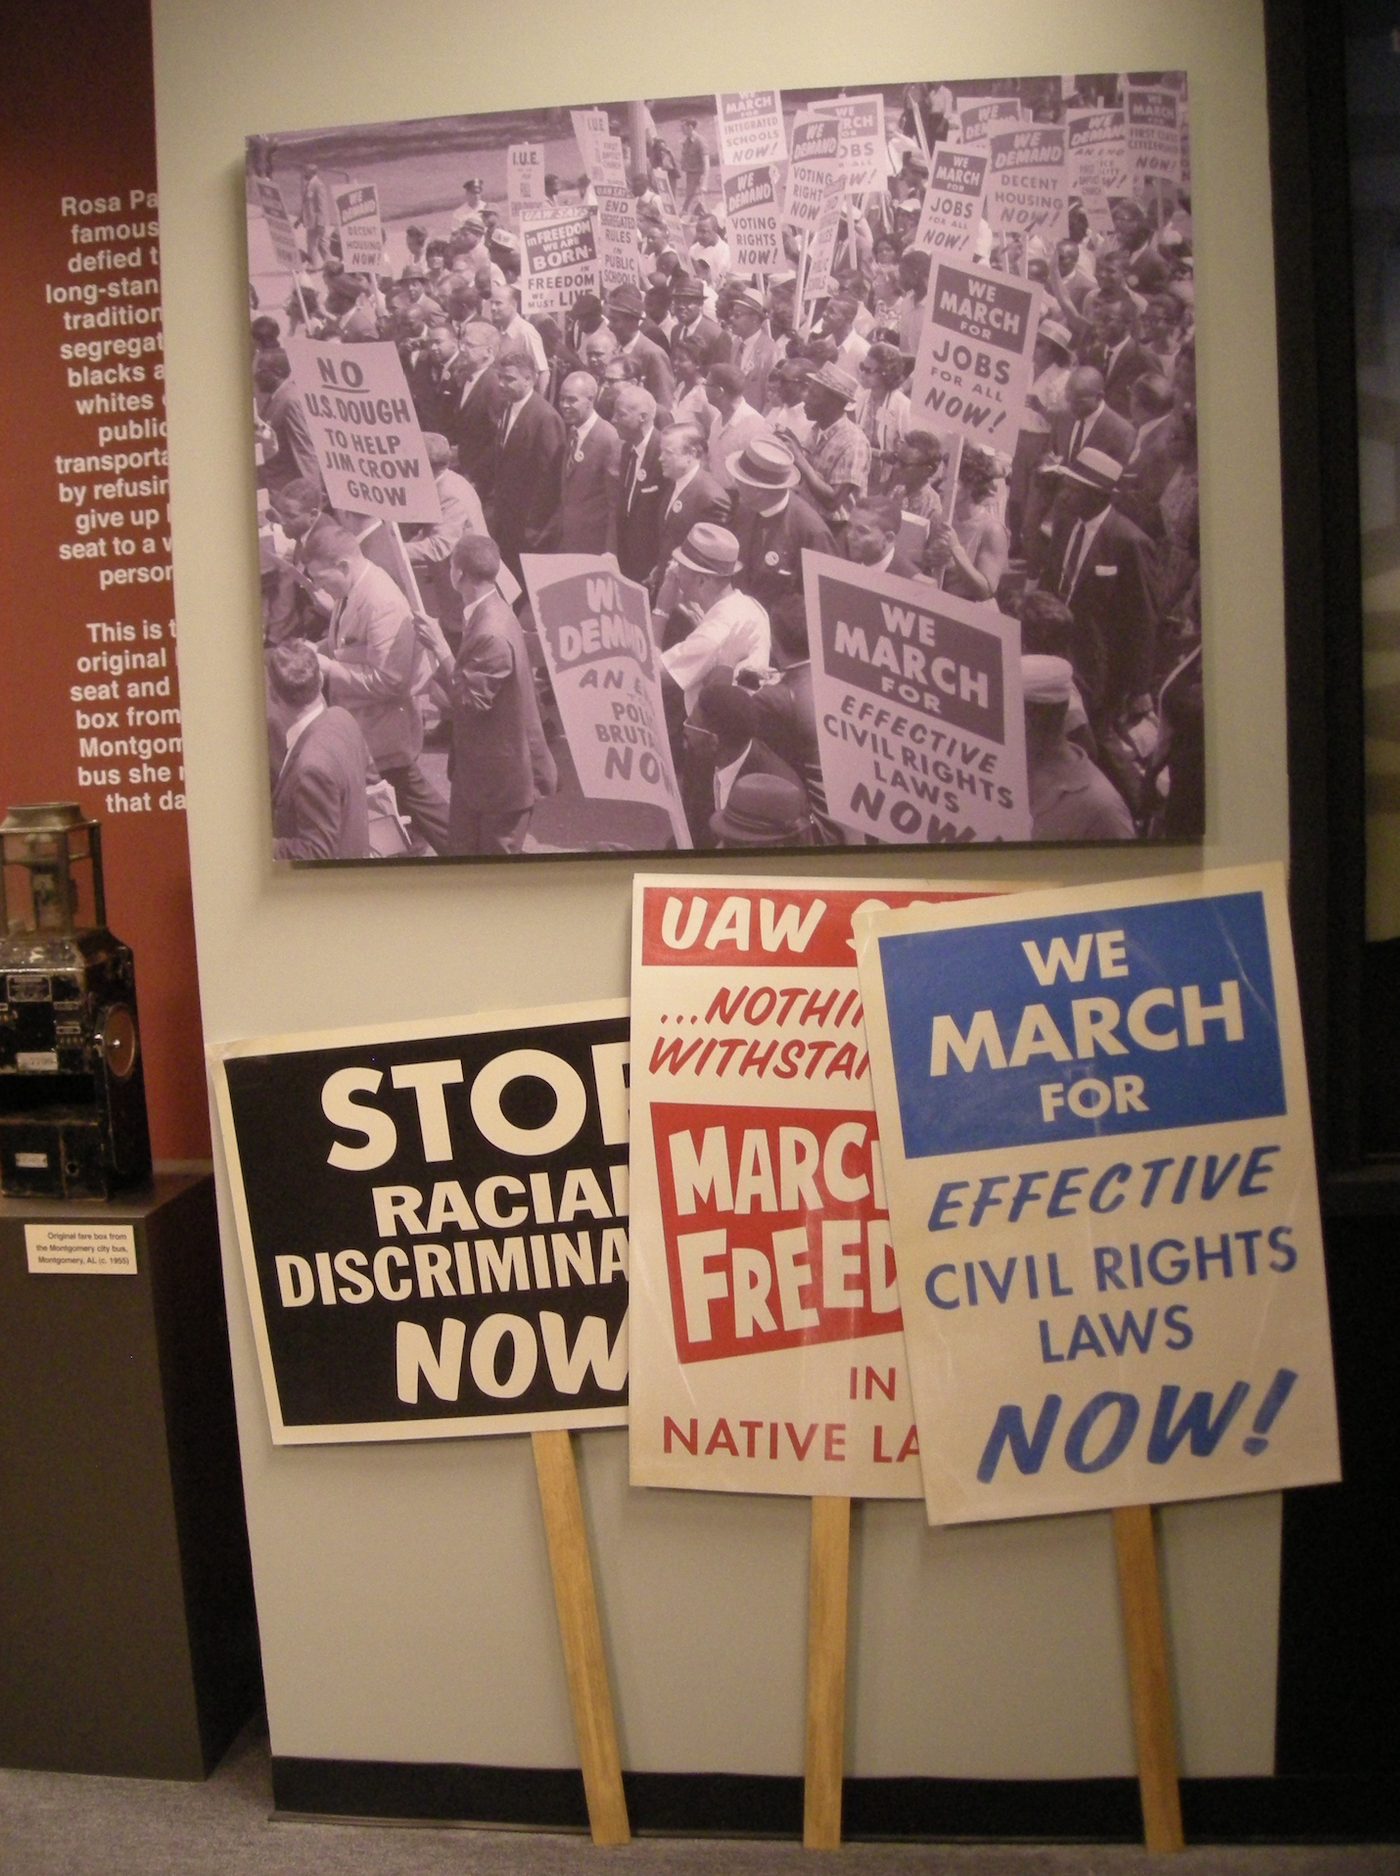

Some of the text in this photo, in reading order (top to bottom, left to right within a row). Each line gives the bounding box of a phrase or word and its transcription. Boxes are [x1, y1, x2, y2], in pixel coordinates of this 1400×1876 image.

[726, 97, 773, 115] MARCH
[724, 117, 779, 136] INTEGRATED
[726, 131, 780, 147] SCHOOLS
[805, 122, 825, 141] WE
[732, 142, 779, 163] NOW!
[1014, 131, 1042, 149] WE
[953, 155, 969, 168] WE
[995, 145, 1062, 169] DEMAND
[737, 172, 755, 191] WE
[793, 166, 833, 185] VOTING
[936, 166, 980, 186] MARCH
[946, 183, 965, 192] FOR
[1001, 174, 1058, 190] DECENT
[61, 189, 158, 217] Rosa Pa
[605, 200, 628, 214] END
[728, 183, 772, 213] DEMAND
[930, 197, 973, 218] JOBS
[995, 191, 1063, 209] HOUSING
[71, 220, 160, 245] famous
[537, 220, 591, 245] FREEDOM
[732, 216, 777, 230] VOTING
[736, 233, 777, 247] RIGHTS
[923, 229, 970, 251] NOW!
[67, 247, 142, 273] defied
[605, 254, 635, 271] PUBLIC
[737, 248, 778, 265] NOW!
[46, 277, 160, 305] long-stan
[528, 273, 594, 290] FREEDOM
[968, 278, 997, 303] WE
[63, 305, 162, 330] tradition
[939, 290, 1020, 335] MARCH
[960, 321, 992, 341] FOR
[60, 332, 164, 362] segregat
[67, 363, 145, 388] blacks
[316, 357, 364, 388] NO
[932, 340, 1010, 385] JOBS
[930, 366, 1003, 403] FOR ALL
[76, 391, 154, 415] whites
[304, 393, 412, 425] U.S. DOUGH
[924, 386, 1008, 434] NOW!
[98, 417, 168, 447] public
[324, 428, 401, 455] TO HELP
[55, 448, 170, 474] transporta
[326, 451, 420, 480] JIM CROW
[59, 482, 87, 507] by
[347, 479, 408, 507] GROW
[75, 507, 160, 535] give up
[59, 537, 107, 561] seat
[112, 536, 136, 557] to
[142, 538, 156, 554] a
[86, 620, 136, 643] This
[142, 619, 163, 640] is
[880, 600, 936, 648] WE
[558, 613, 647, 663] DEMD
[77, 647, 166, 676] original
[834, 620, 989, 709] MARCH
[70, 676, 170, 702] seat and
[579, 668, 624, 690] AN
[881, 676, 942, 714] FOR
[75, 705, 181, 730] box from
[79, 735, 183, 760] Montgom
[840, 694, 998, 775] EFFECTIVE
[823, 713, 1014, 810] CIVIL RIGHTS
[77, 765, 121, 787] bus
[128, 763, 171, 784] she
[873, 760, 960, 814] LAWS
[105, 790, 187, 814] that da
[850, 782, 1004, 844] NOW
[661, 895, 828, 954] UAW
[1021, 929, 1130, 987] WE
[929, 979, 1245, 1077] MARCH
[1039, 1073, 1150, 1122] FOR
[927, 1144, 1282, 1232] EFFECTIVE
[48, 1232, 127, 1241] Original fare box from
[49, 1244, 95, 1253] Montgomery
[97, 1245, 110, 1253] city
[275, 1227, 630, 1308] DISCRIMINA
[924, 1225, 1299, 1310] CIVIL RIGHTS
[676, 1219, 901, 1344] FREED
[1038, 1304, 1194, 1364] LAWS
[396, 1302, 630, 1405] NOW
[850, 1366, 897, 1401] IN
[976, 1367, 1299, 1485] NOW!
[663, 1415, 921, 1464] NATIVE LA
